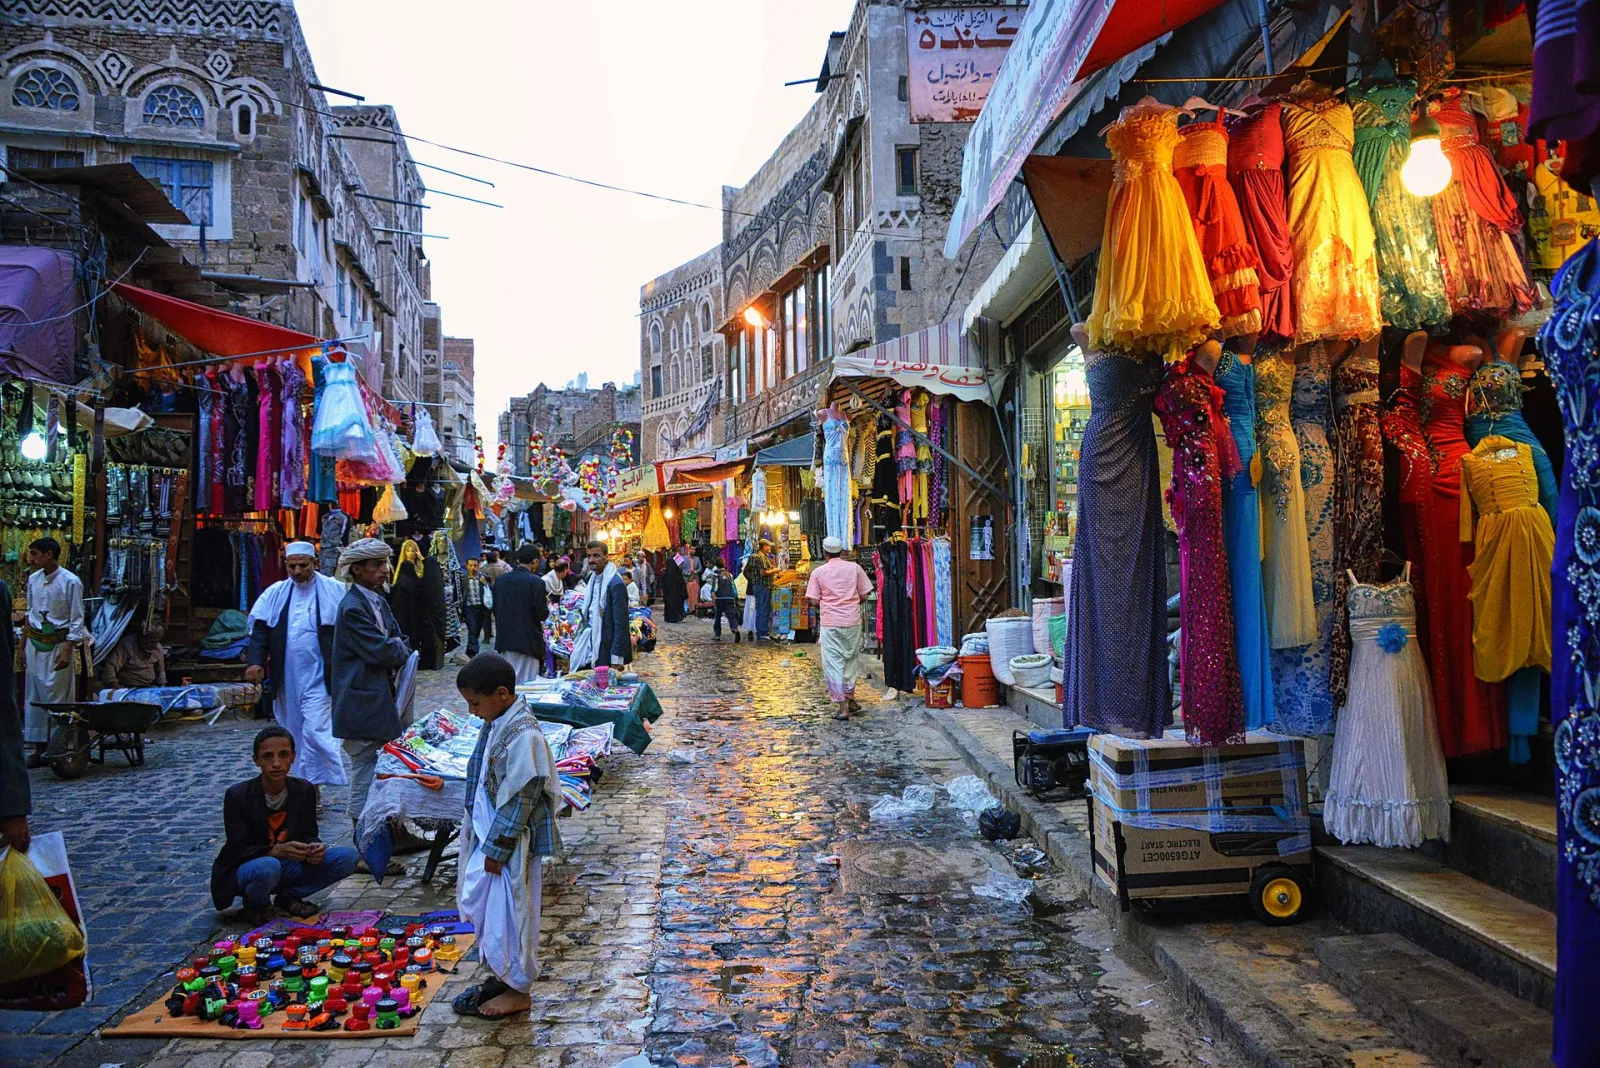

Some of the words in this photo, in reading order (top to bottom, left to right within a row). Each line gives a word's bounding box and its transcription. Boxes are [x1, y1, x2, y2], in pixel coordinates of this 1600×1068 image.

[1168, 784, 1197, 793] GERMAN
[1141, 841, 1164, 849] START
[1166, 839, 1201, 848] ELECTRIC
[1141, 850, 1201, 863] ATG6500CET
